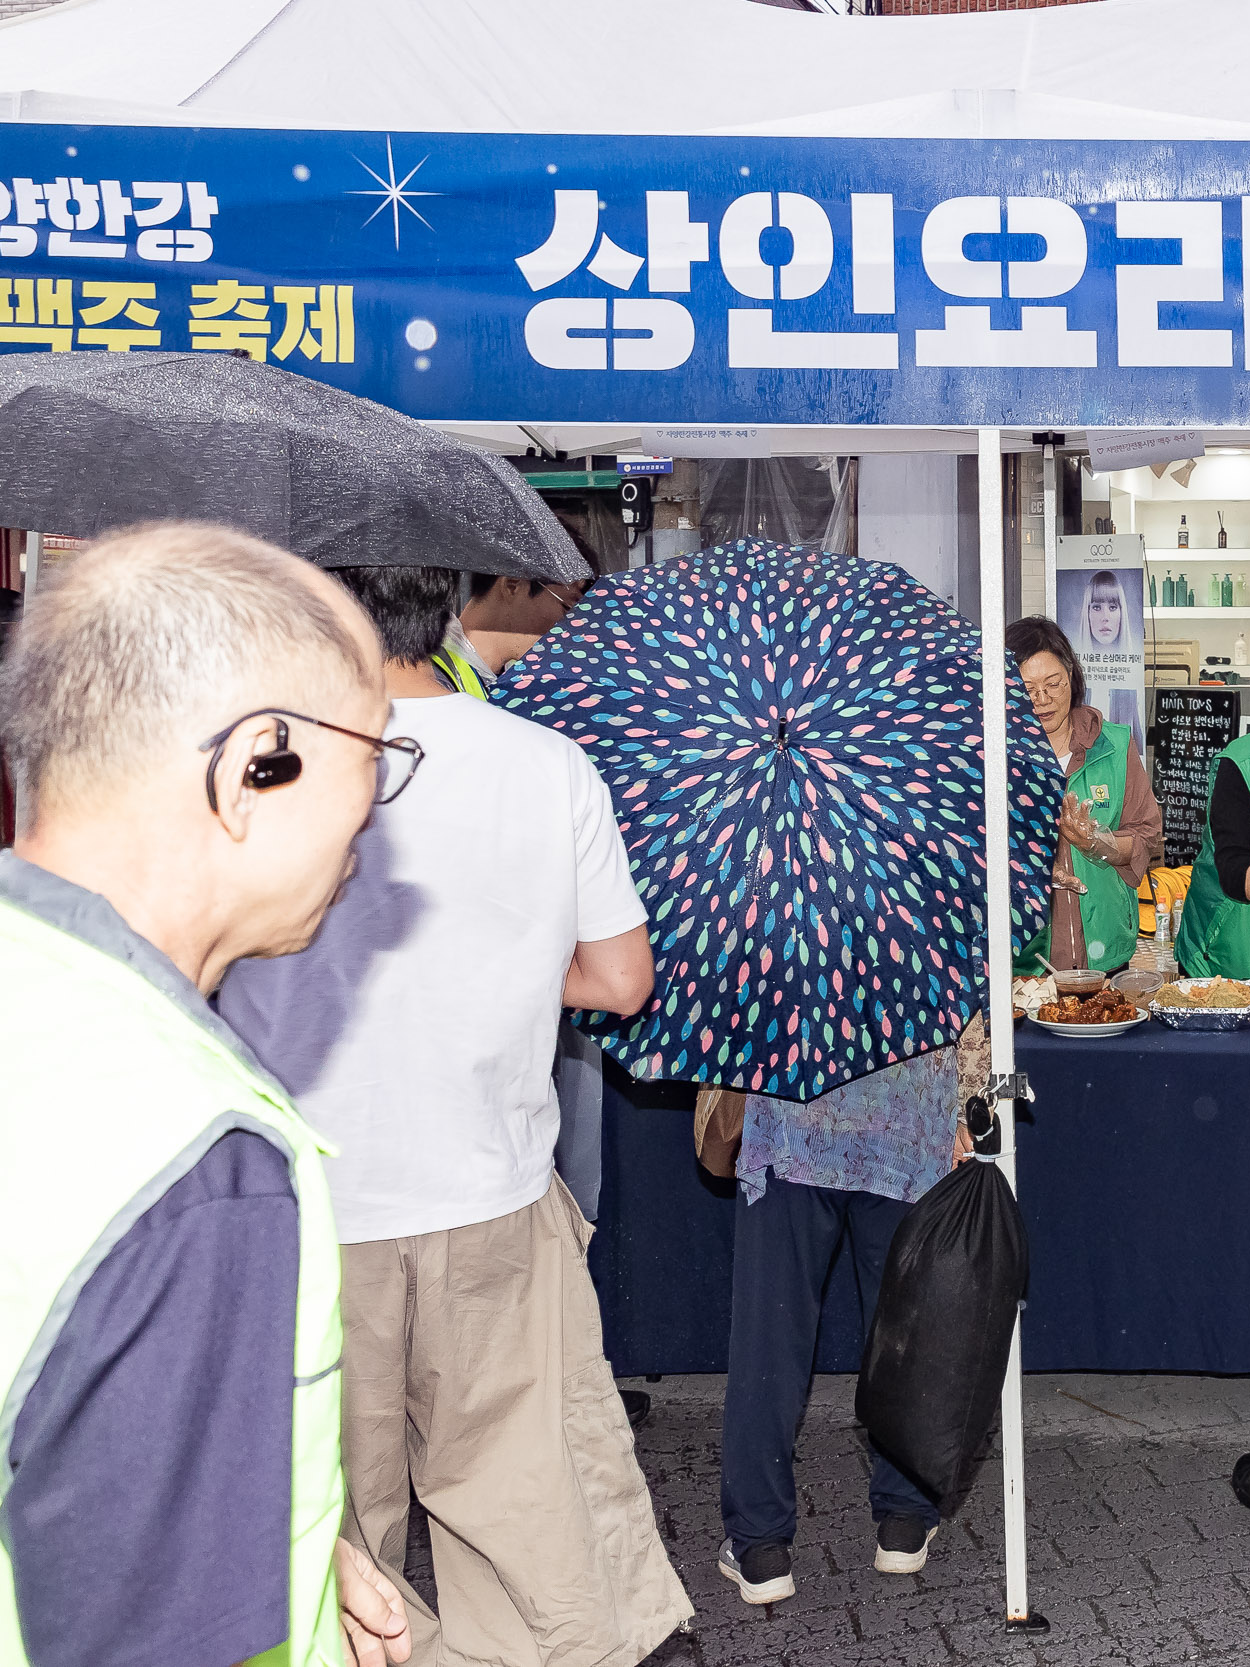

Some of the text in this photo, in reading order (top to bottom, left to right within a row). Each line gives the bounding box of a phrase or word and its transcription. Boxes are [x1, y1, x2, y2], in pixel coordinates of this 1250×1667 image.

[188, 279, 355, 364] 축제
[1162, 697, 1185, 710] HAIR
[1167, 794, 1189, 806] QOD
